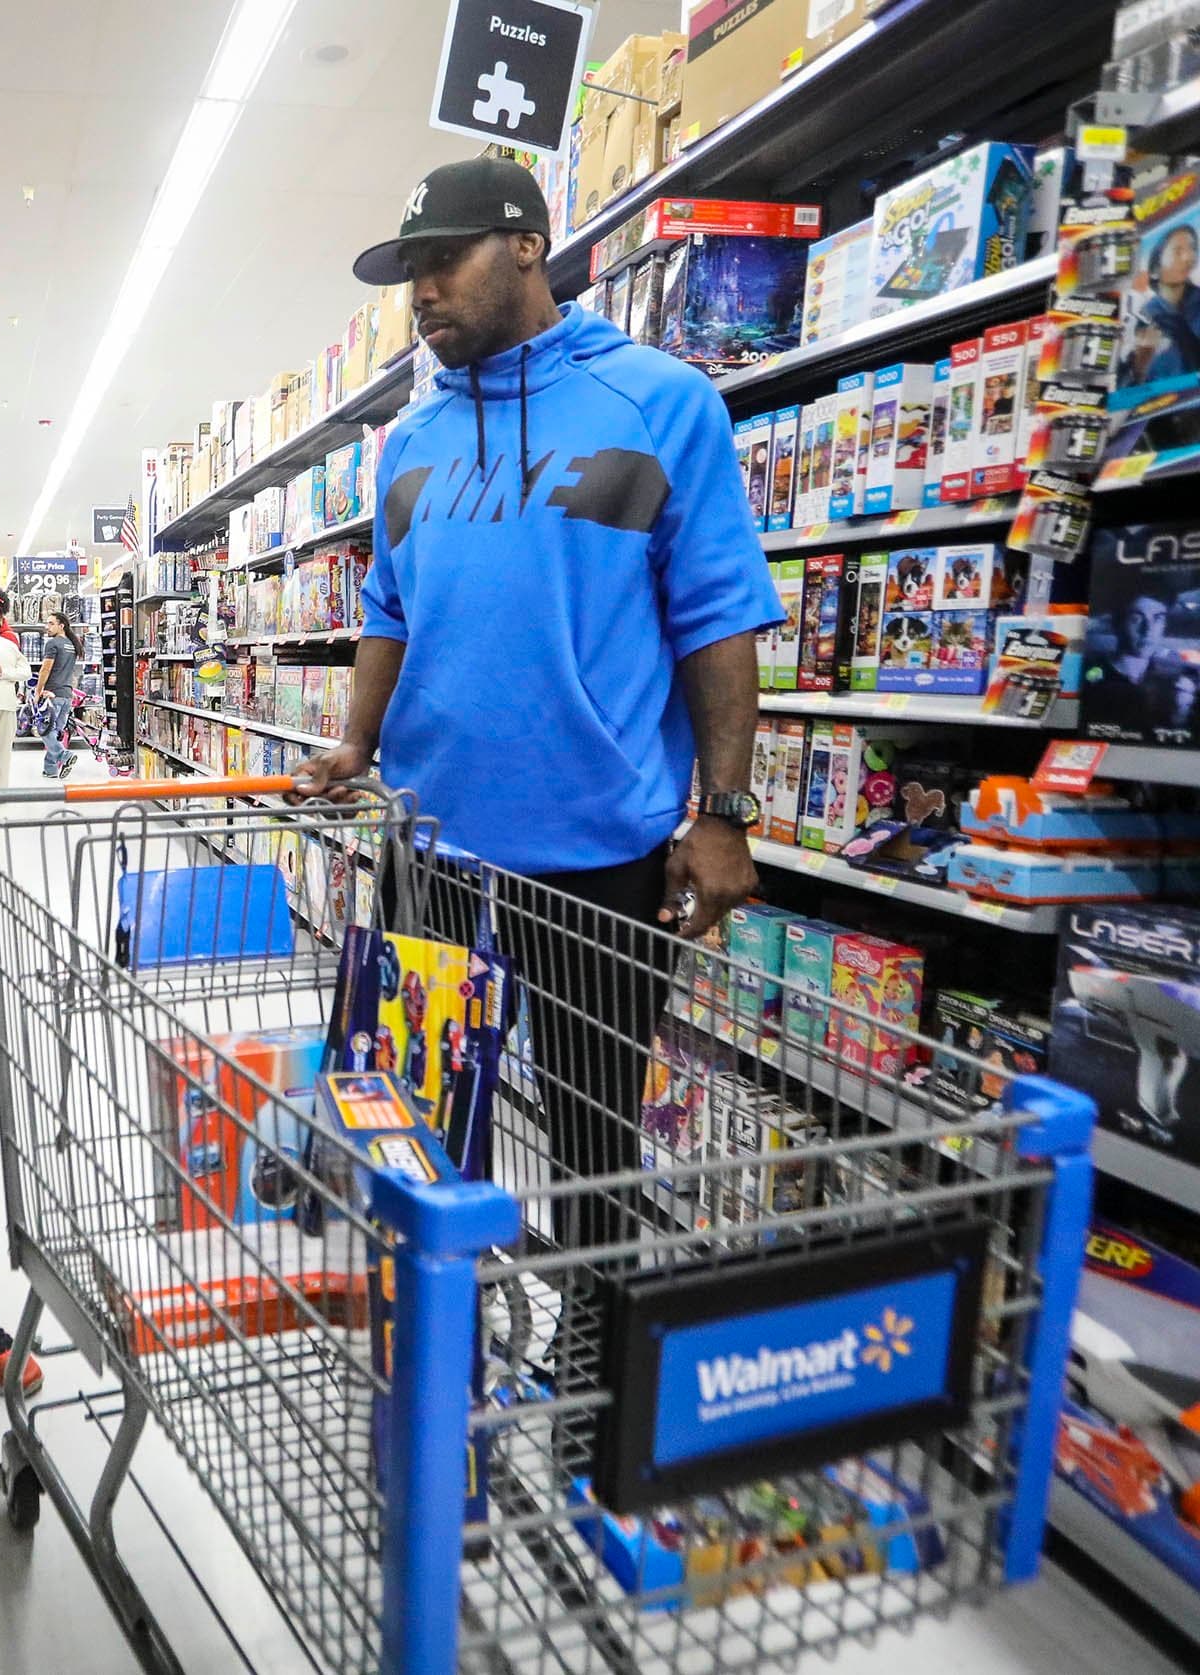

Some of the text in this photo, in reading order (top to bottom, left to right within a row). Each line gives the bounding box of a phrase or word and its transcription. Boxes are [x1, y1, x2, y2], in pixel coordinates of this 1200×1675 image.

[490, 16, 547, 47] Puzzles
[713, 2, 758, 41] PUZZLES
[991, 331, 1018, 346] 550
[954, 348, 977, 362] 500
[842, 378, 860, 390] 1000
[878, 371, 898, 384] 1000
[48, 562, 65, 570] Price
[1070, 913, 1193, 963] LASER
[1085, 1234, 1153, 1270] ERF
[697, 1329, 858, 1402] Walmart
